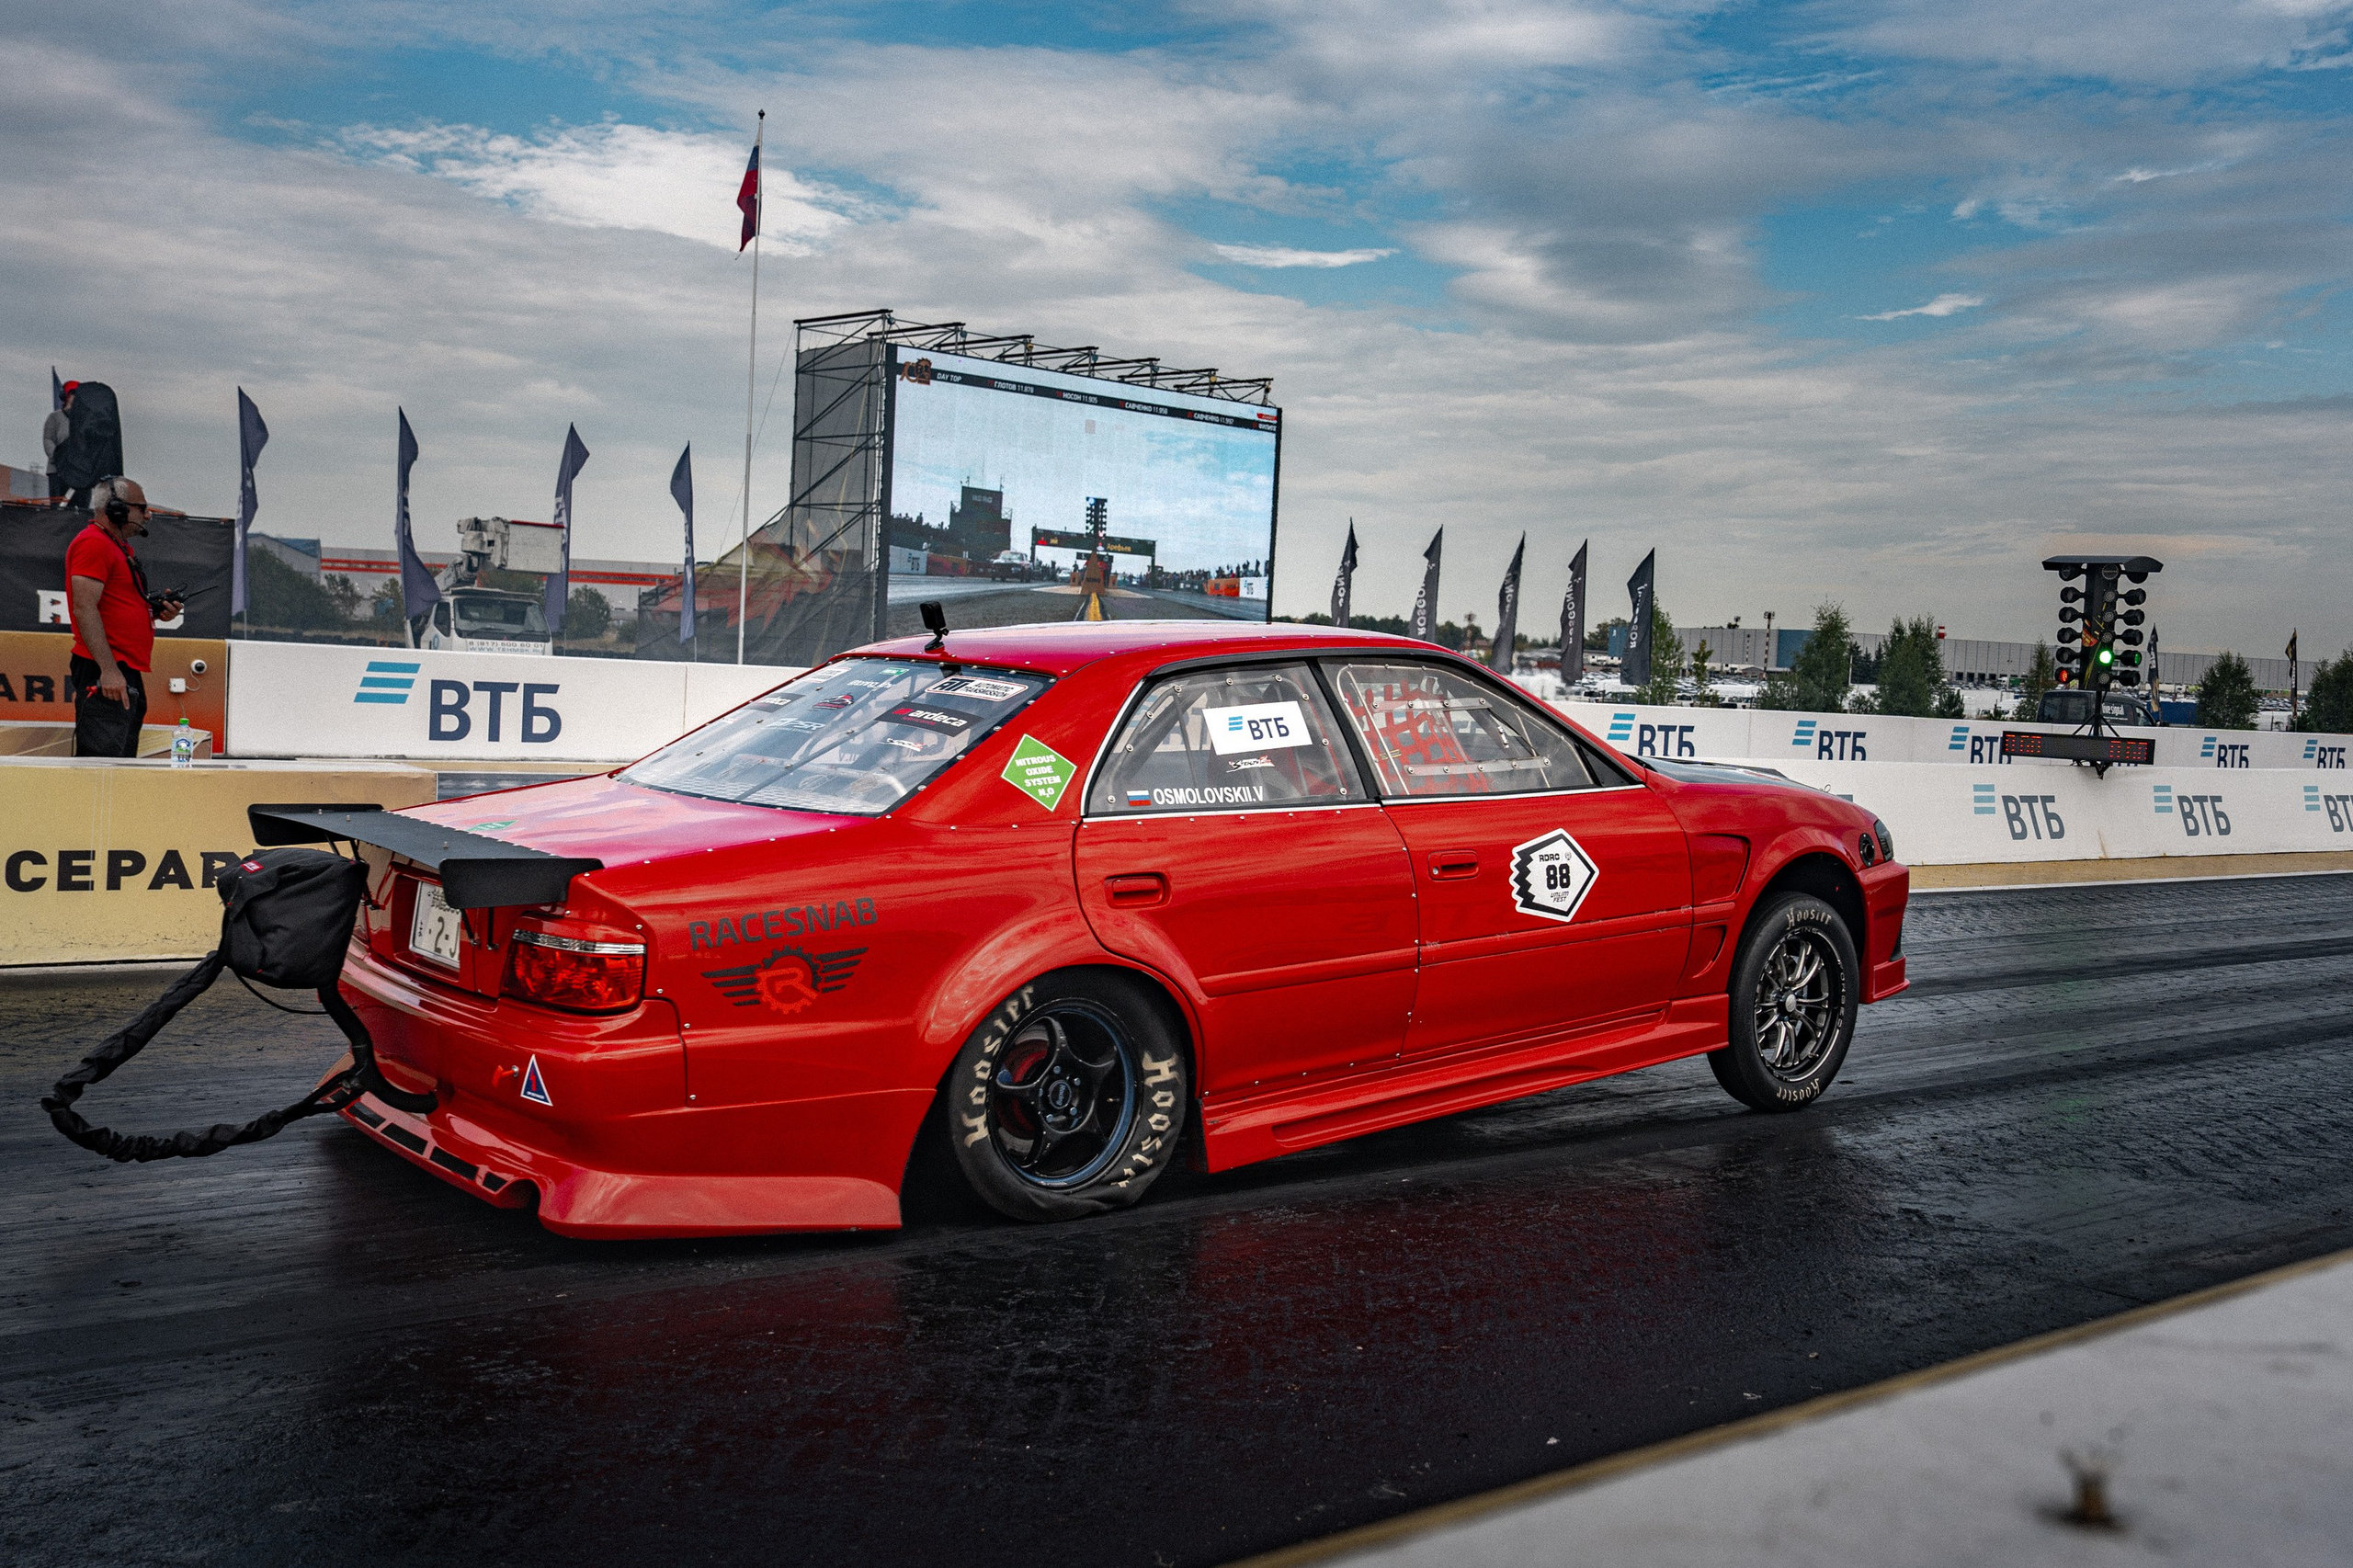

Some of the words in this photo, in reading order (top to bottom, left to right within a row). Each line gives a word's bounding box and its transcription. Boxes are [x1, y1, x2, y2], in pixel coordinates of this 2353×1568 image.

[937, 372, 949, 381] DAY
[949, 374, 962, 383] TOP
[428, 679, 563, 744] ВТБ
[908, 710, 968, 727] ardeca
[1247, 716, 1290, 741] ВТБ
[1638, 723, 1695, 756] ВТБ
[1818, 730, 1867, 760] ВТБ
[2217, 744, 2250, 768] ВТБ
[2317, 746, 2346, 768] ВТБ
[1015, 754, 1056, 767] NITROUS
[1025, 765, 1054, 777] OXIDE
[1024, 775, 1062, 788] SYSTEM
[1153, 786, 1264, 805] OSMOLOVSKII.V
[2001, 794, 2065, 840] ВТБ
[2177, 795, 2232, 836] ВТБ
[2323, 794, 2353, 833] ВТ
[1539, 853, 1561, 863] RDRC
[1546, 863, 1571, 890] 88
[689, 896, 878, 951] RACESNAB
[1786, 907, 1832, 930] Hoosier
